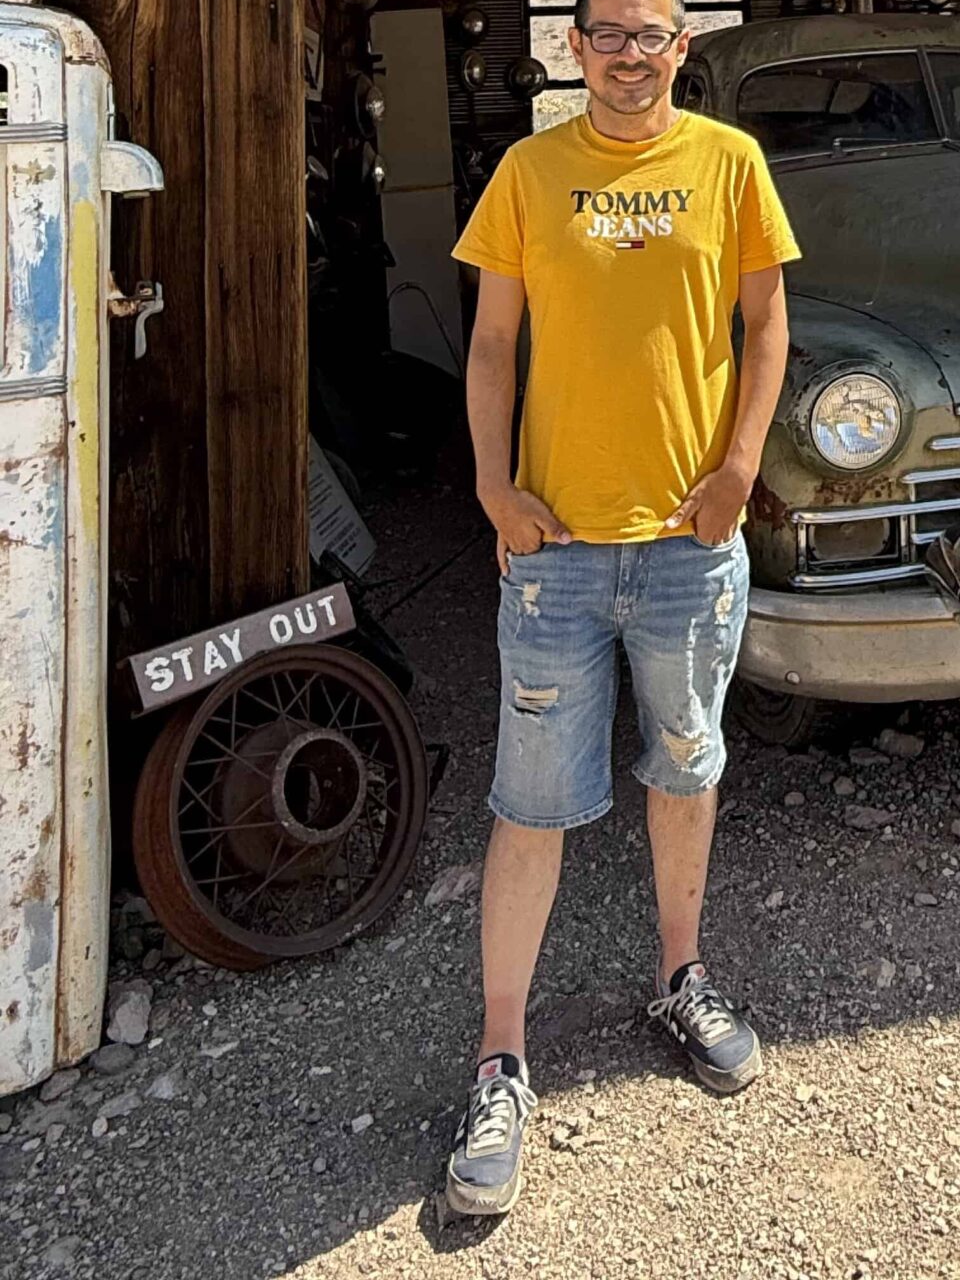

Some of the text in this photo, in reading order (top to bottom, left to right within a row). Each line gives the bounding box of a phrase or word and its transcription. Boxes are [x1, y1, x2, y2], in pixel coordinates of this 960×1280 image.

[570, 189, 695, 215] TOMMY
[586, 214, 673, 238] JEANS
[144, 595, 338, 692] STAY OUT
